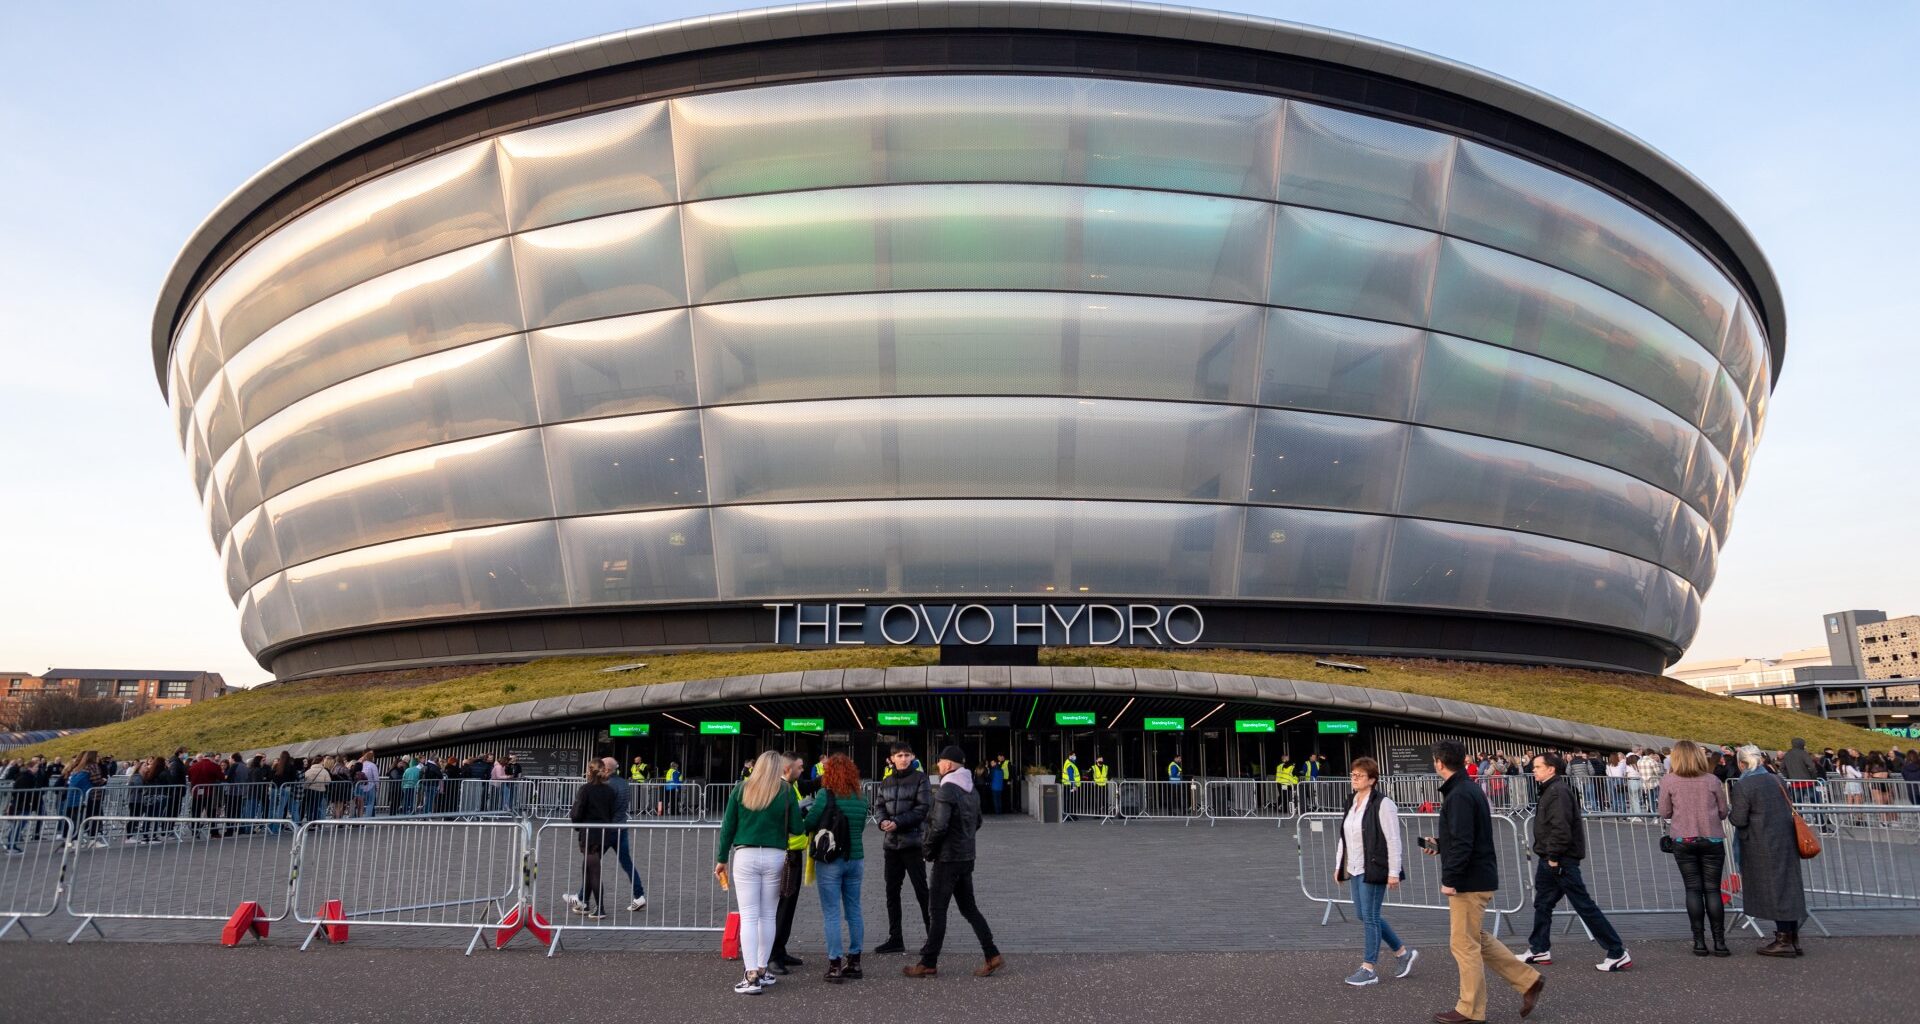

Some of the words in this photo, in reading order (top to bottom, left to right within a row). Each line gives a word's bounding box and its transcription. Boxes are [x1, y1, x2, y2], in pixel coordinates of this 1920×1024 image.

[763, 603, 866, 644] THE
[880, 603, 995, 645] OVO
[1013, 603, 1204, 645] HYDRO
